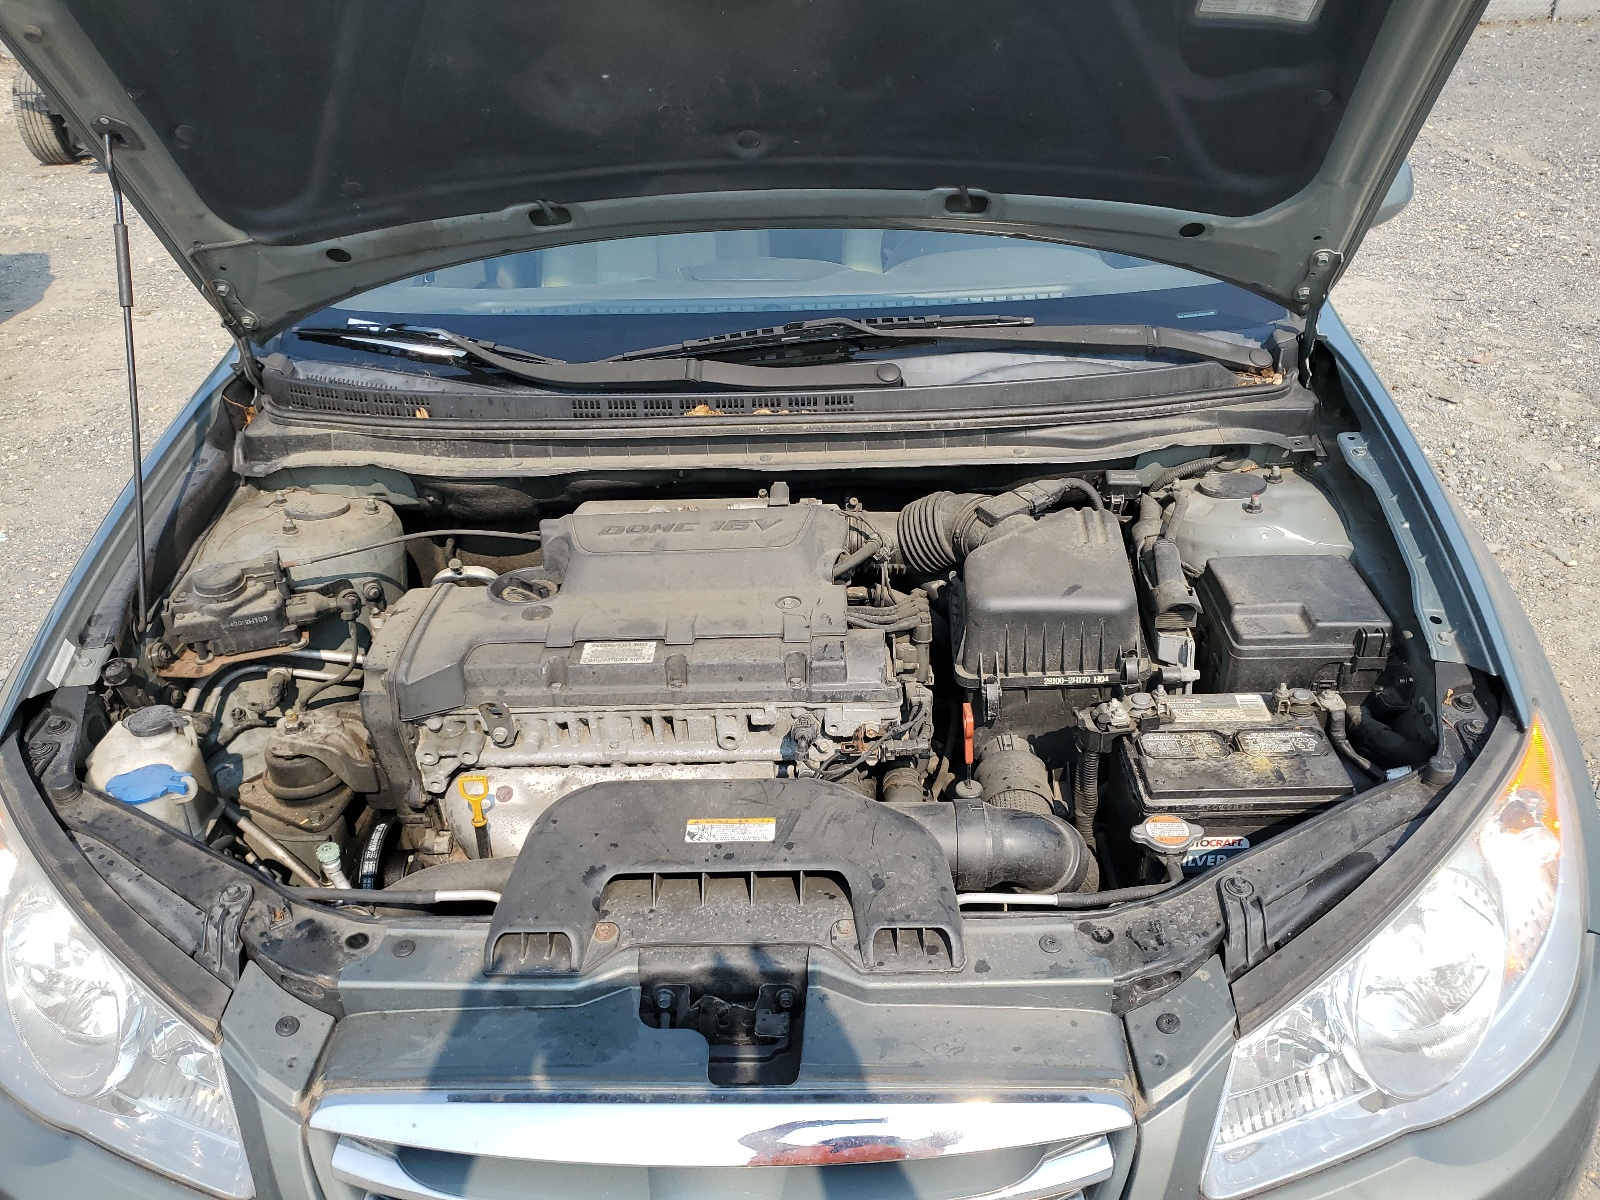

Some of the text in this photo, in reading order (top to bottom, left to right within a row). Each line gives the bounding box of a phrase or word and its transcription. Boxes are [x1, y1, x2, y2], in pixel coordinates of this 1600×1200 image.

[598, 518, 784, 536] DOHC 16V
[1190, 838, 1243, 848] TOCRAFT
